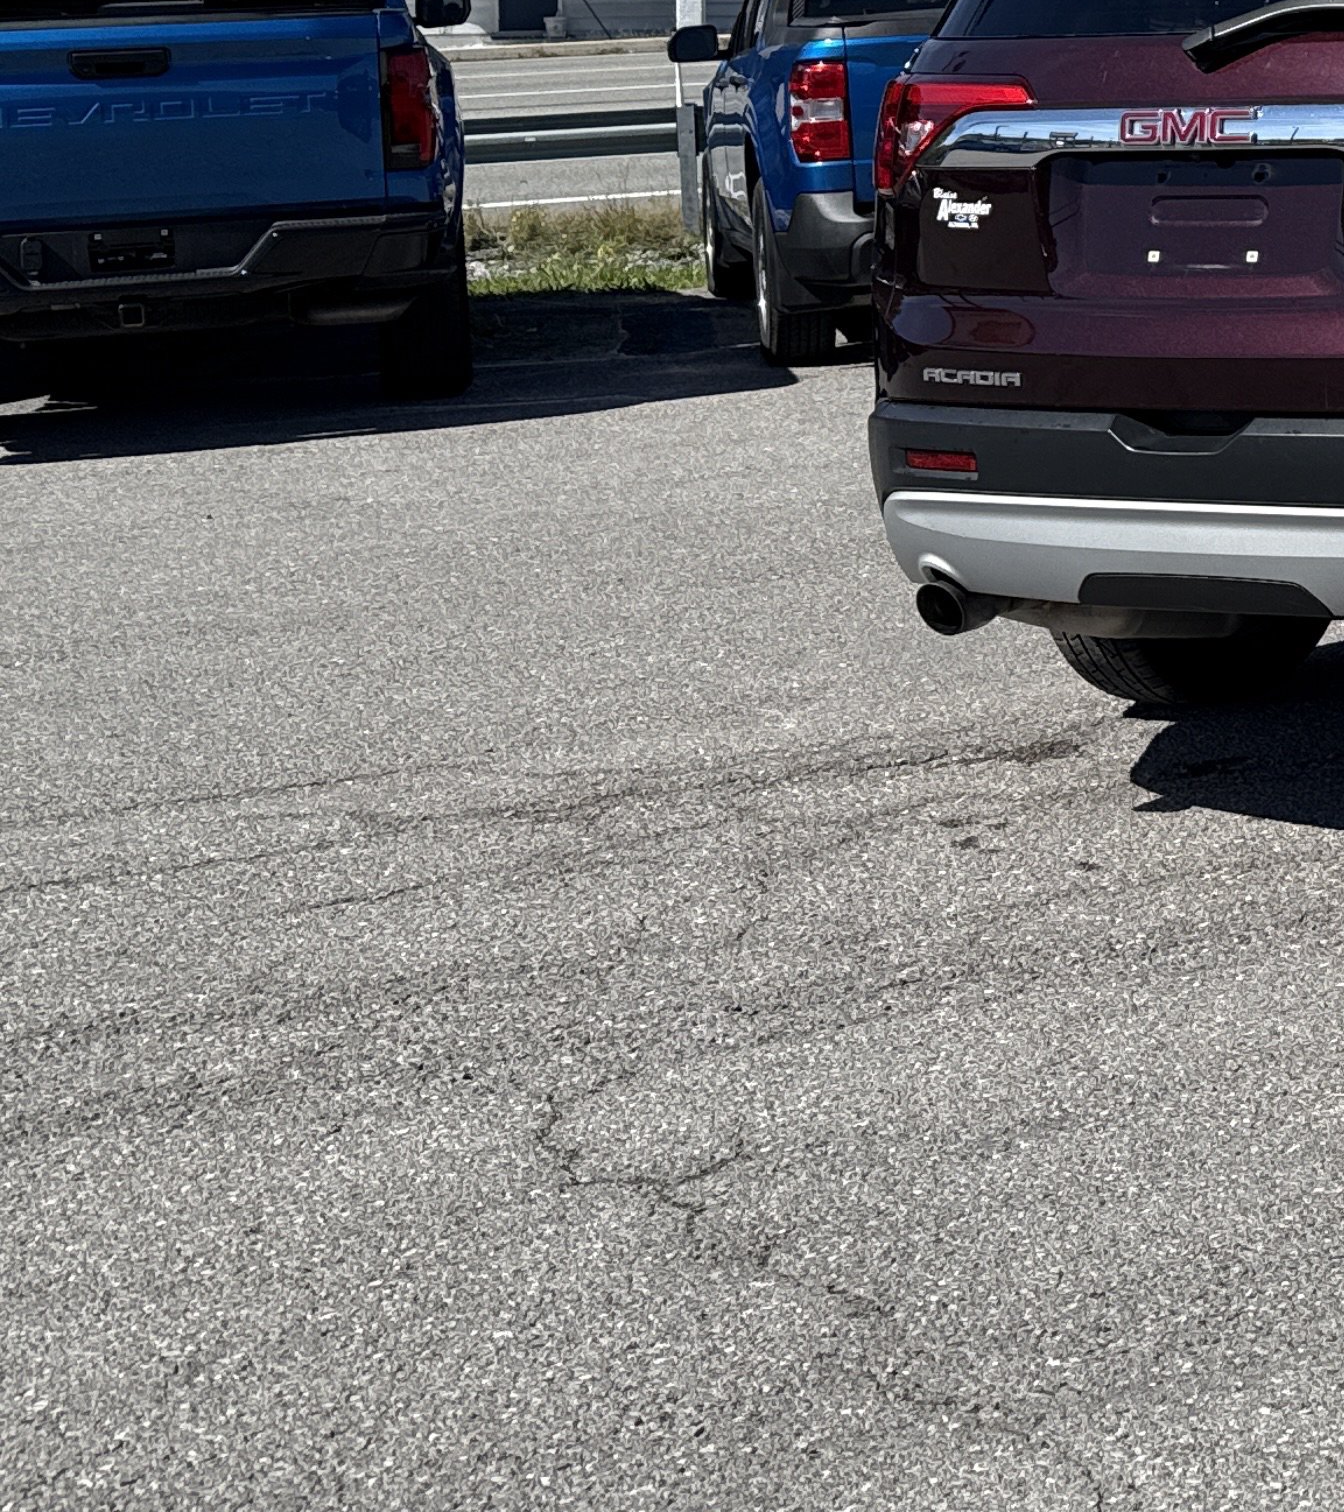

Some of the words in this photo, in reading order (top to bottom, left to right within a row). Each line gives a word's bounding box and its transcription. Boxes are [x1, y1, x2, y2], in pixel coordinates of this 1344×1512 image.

[0, 92, 327, 128] EVROLET
[1120, 109, 1257, 145] GMC
[936, 199, 992, 221] Alexander
[922, 367, 1022, 386] ACADIA
